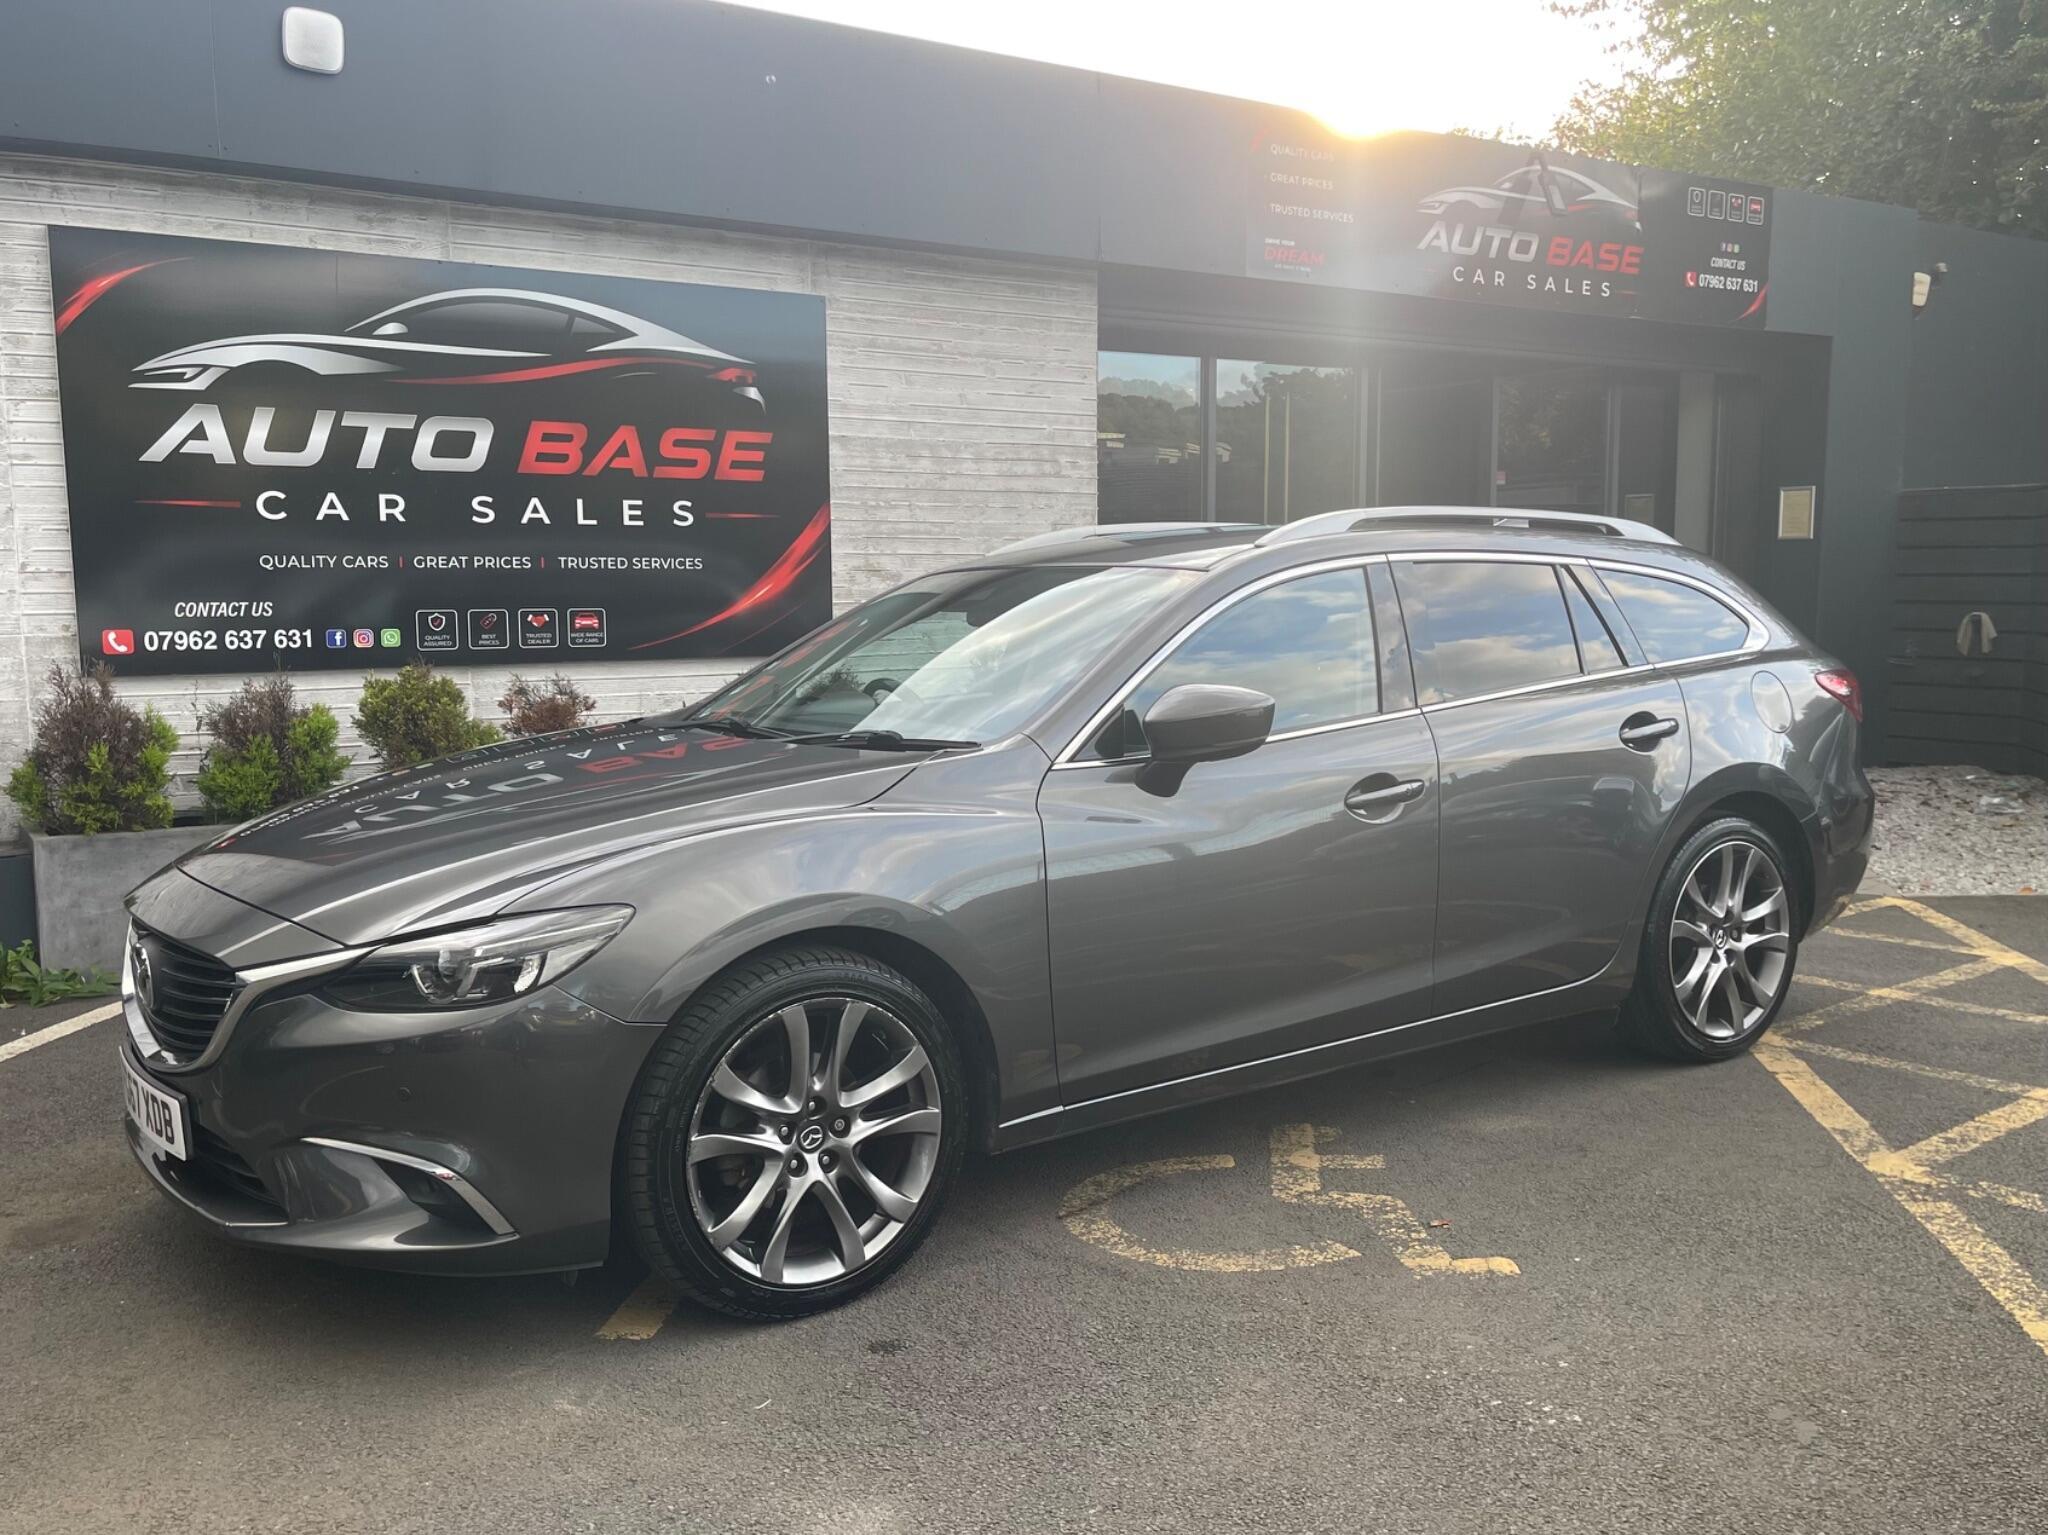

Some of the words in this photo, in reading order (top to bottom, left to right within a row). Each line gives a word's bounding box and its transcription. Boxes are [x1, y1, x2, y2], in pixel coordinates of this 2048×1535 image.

[1270, 172, 1299, 185] GREAT
[1302, 177, 1333, 190] PRICES
[1270, 203, 1310, 217] TRUSTED
[1312, 209, 1354, 224] SERVICES
[1416, 220, 1540, 263] AUTO
[1546, 236, 1644, 275] BASE
[1710, 257, 1737, 269] CONTACT
[1737, 261, 1746, 271] US
[1453, 266, 1505, 287] CAR
[1527, 274, 1611, 297] SALES
[1699, 274, 1725, 289] 07962
[1726, 277, 1742, 290] 637
[1743, 279, 1758, 293] 631
[138, 403, 495, 473] AUTO
[517, 420, 773, 482] BASE
[256, 490, 406, 522] CAR
[472, 495, 695, 527] SALES
[259, 554, 337, 571] QUALITY
[342, 555, 389, 569] CARS
[413, 556, 470, 570] GREAT
[474, 556, 531, 570] PRICES
[558, 556, 628, 570] TRUSTED
[632, 556, 703, 570] SERVICES
[174, 602, 248, 618] CONTACT
[251, 601, 273, 617] US
[143, 630, 218, 651] 07962
[224, 629, 267, 650] 637
[273, 628, 313, 649] 631
[425, 634, 450, 642] QUALITY
[141, 1085, 175, 1145] XDB
